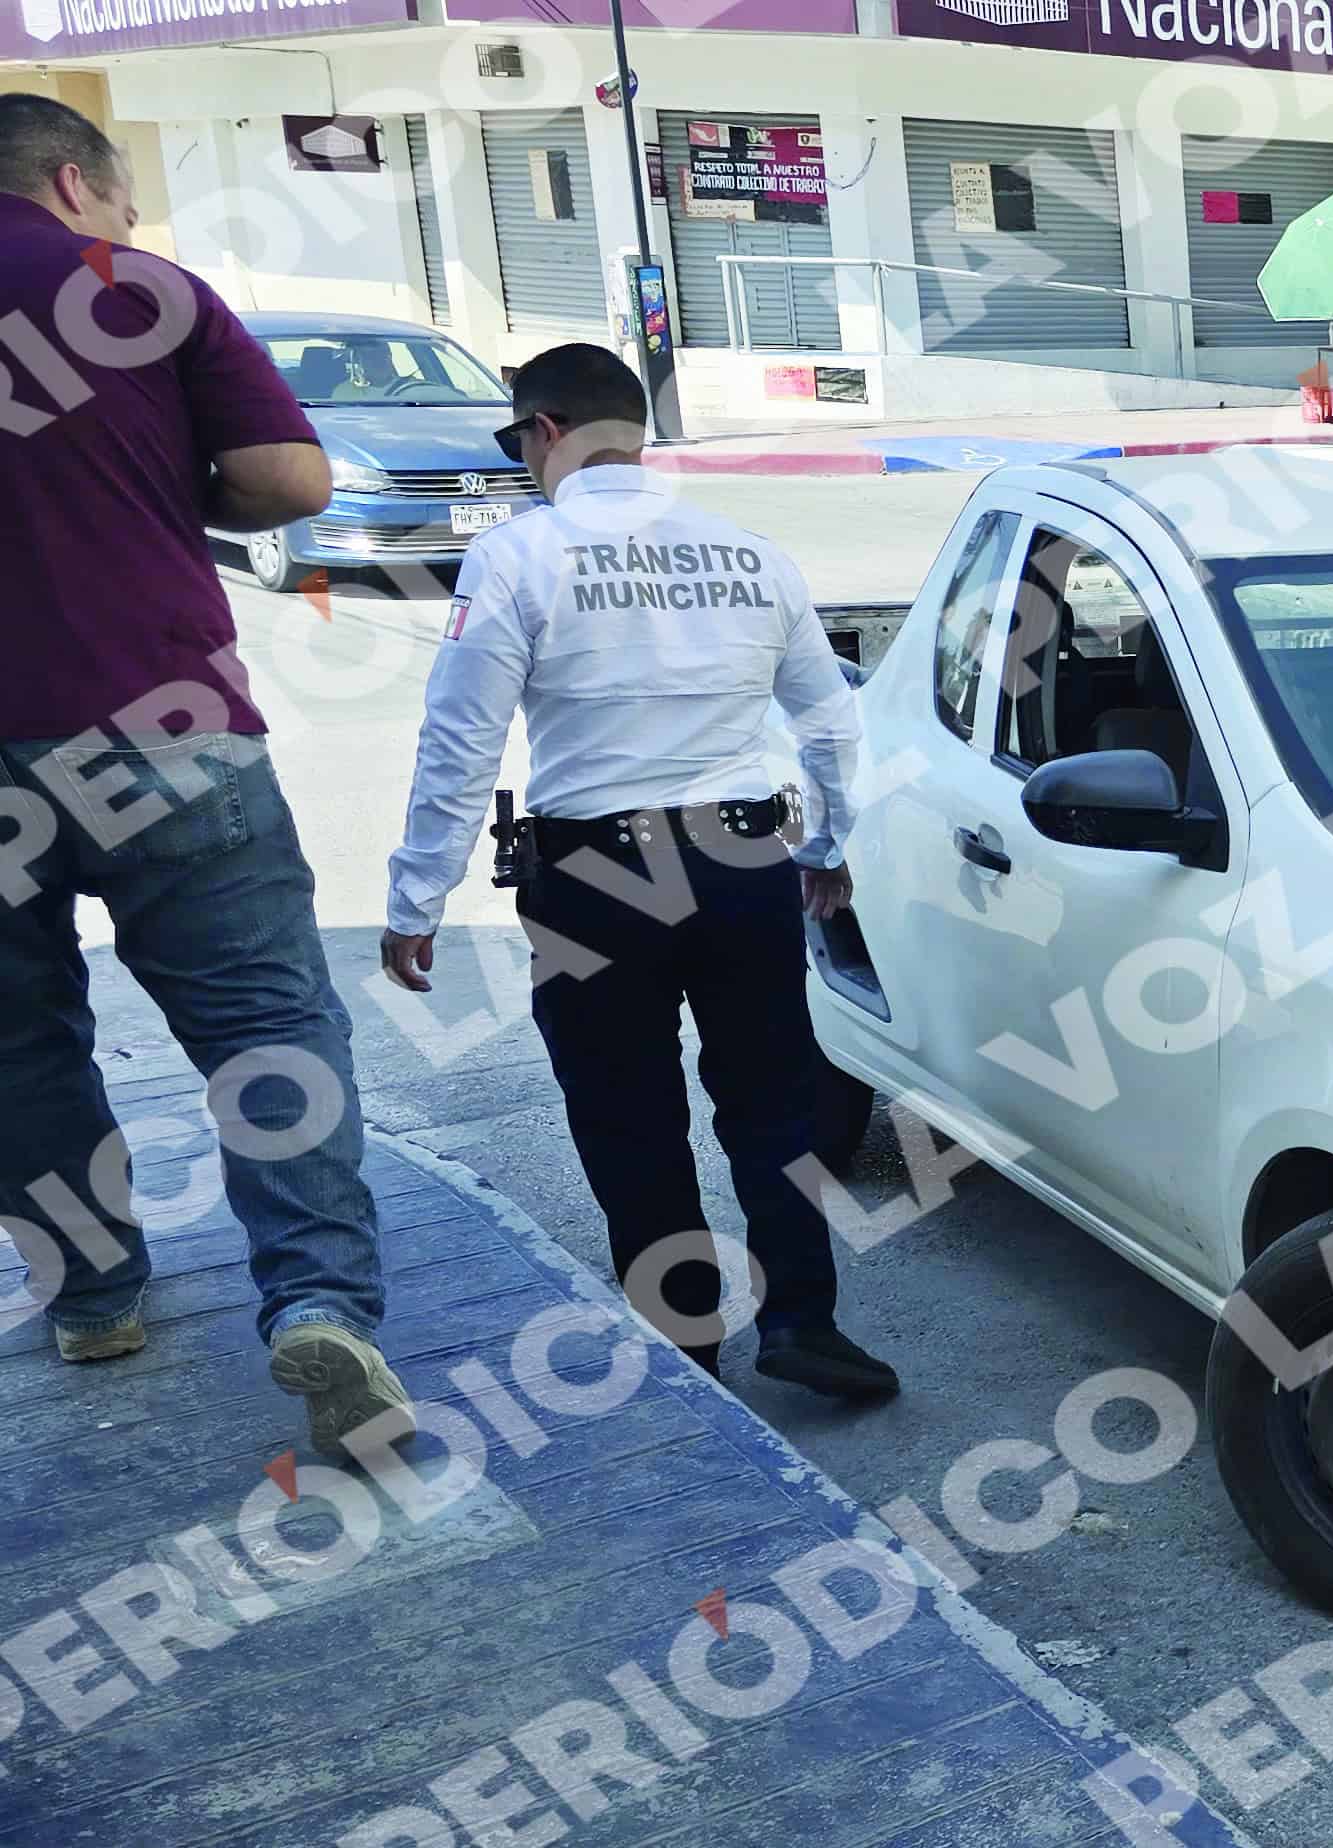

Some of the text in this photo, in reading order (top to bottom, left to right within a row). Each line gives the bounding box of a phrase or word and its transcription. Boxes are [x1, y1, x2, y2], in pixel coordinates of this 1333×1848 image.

[773, 165, 820, 177] NUESTRO
[564, 535, 761, 577] TRÁNSITO
[572, 580, 774, 613] MUNICIPAL
